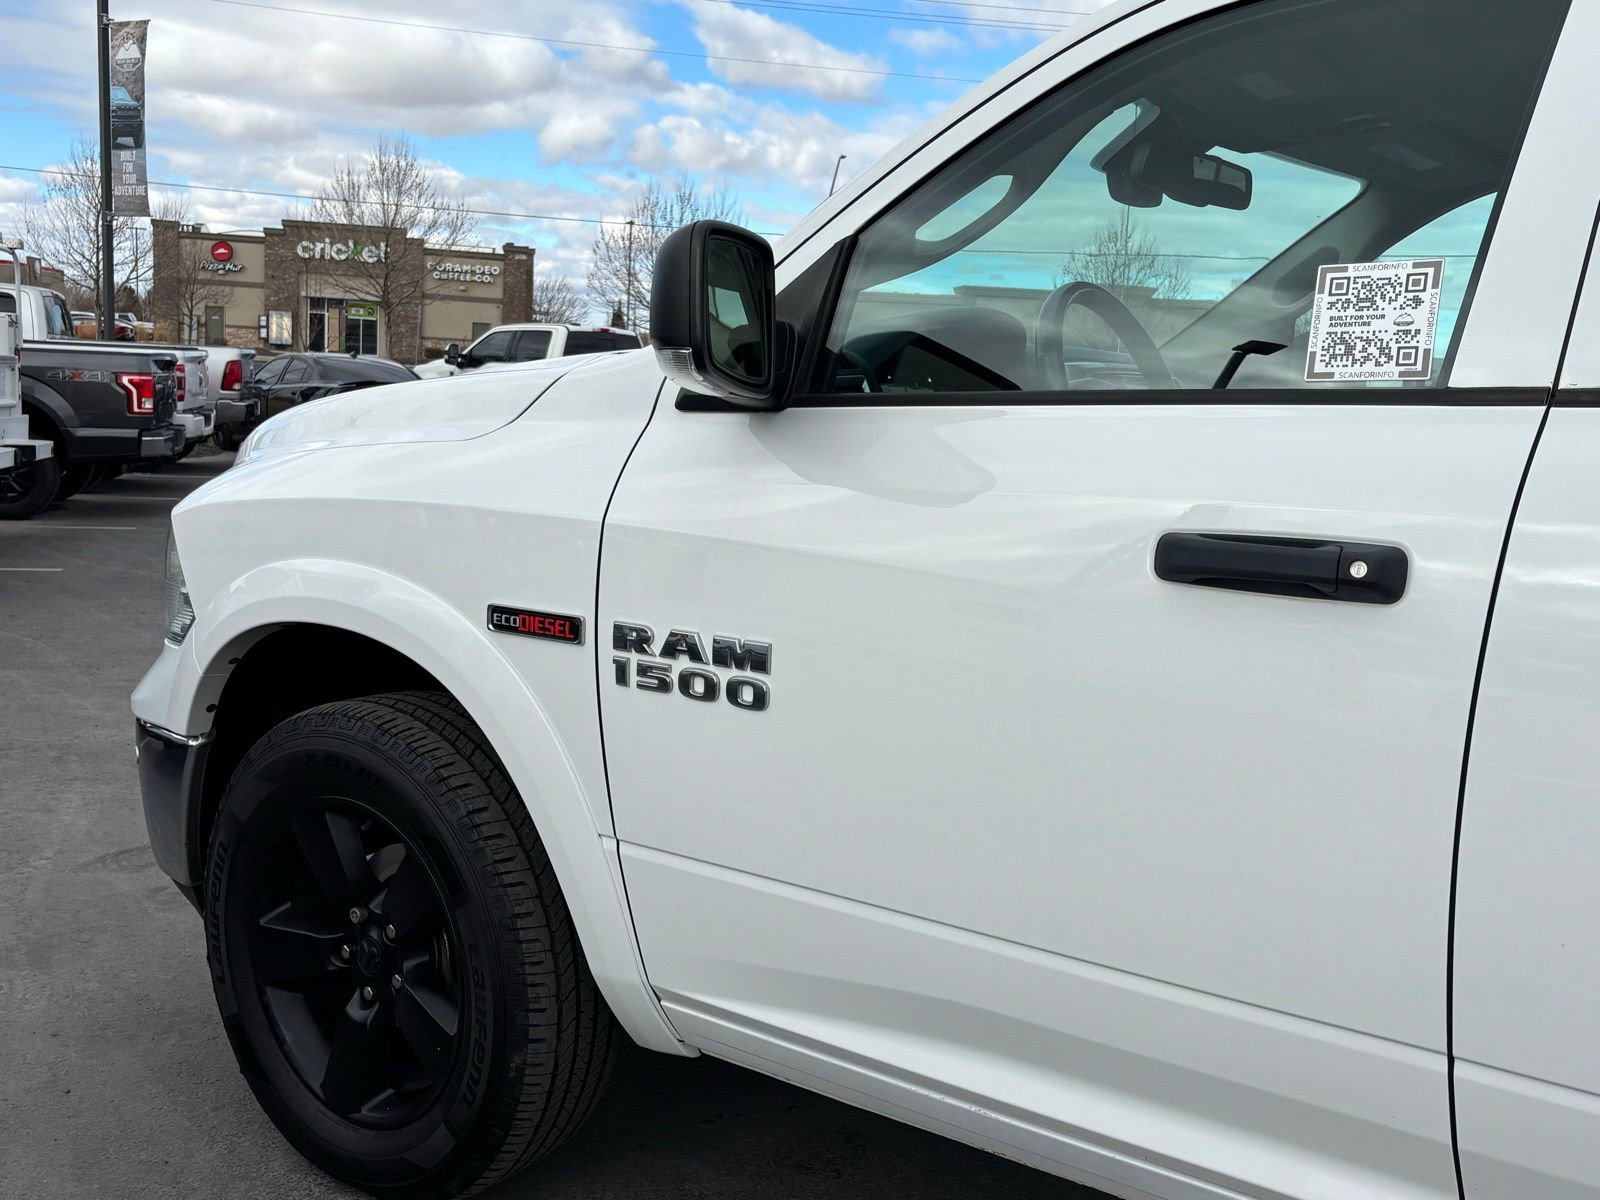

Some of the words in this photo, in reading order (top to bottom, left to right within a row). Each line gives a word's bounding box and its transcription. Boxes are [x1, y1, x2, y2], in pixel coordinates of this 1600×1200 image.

[120, 151, 136, 161] BUILT
[122, 162, 134, 173] FOR
[122, 174, 137, 184] YOUR
[114, 185, 146, 196] ADVENTURE
[296, 238, 391, 264] cricket
[199, 260, 224, 271] Pizza
[225, 262, 243, 272] Hut
[475, 265, 500, 275] DEO
[1352, 262, 1409, 273] SCANFORINFO
[1328, 320, 1372, 328] ADVENTURE
[1338, 371, 1395, 380] SCANFORINFO
[613, 620, 773, 675] RAM
[613, 654, 771, 712] 1500
